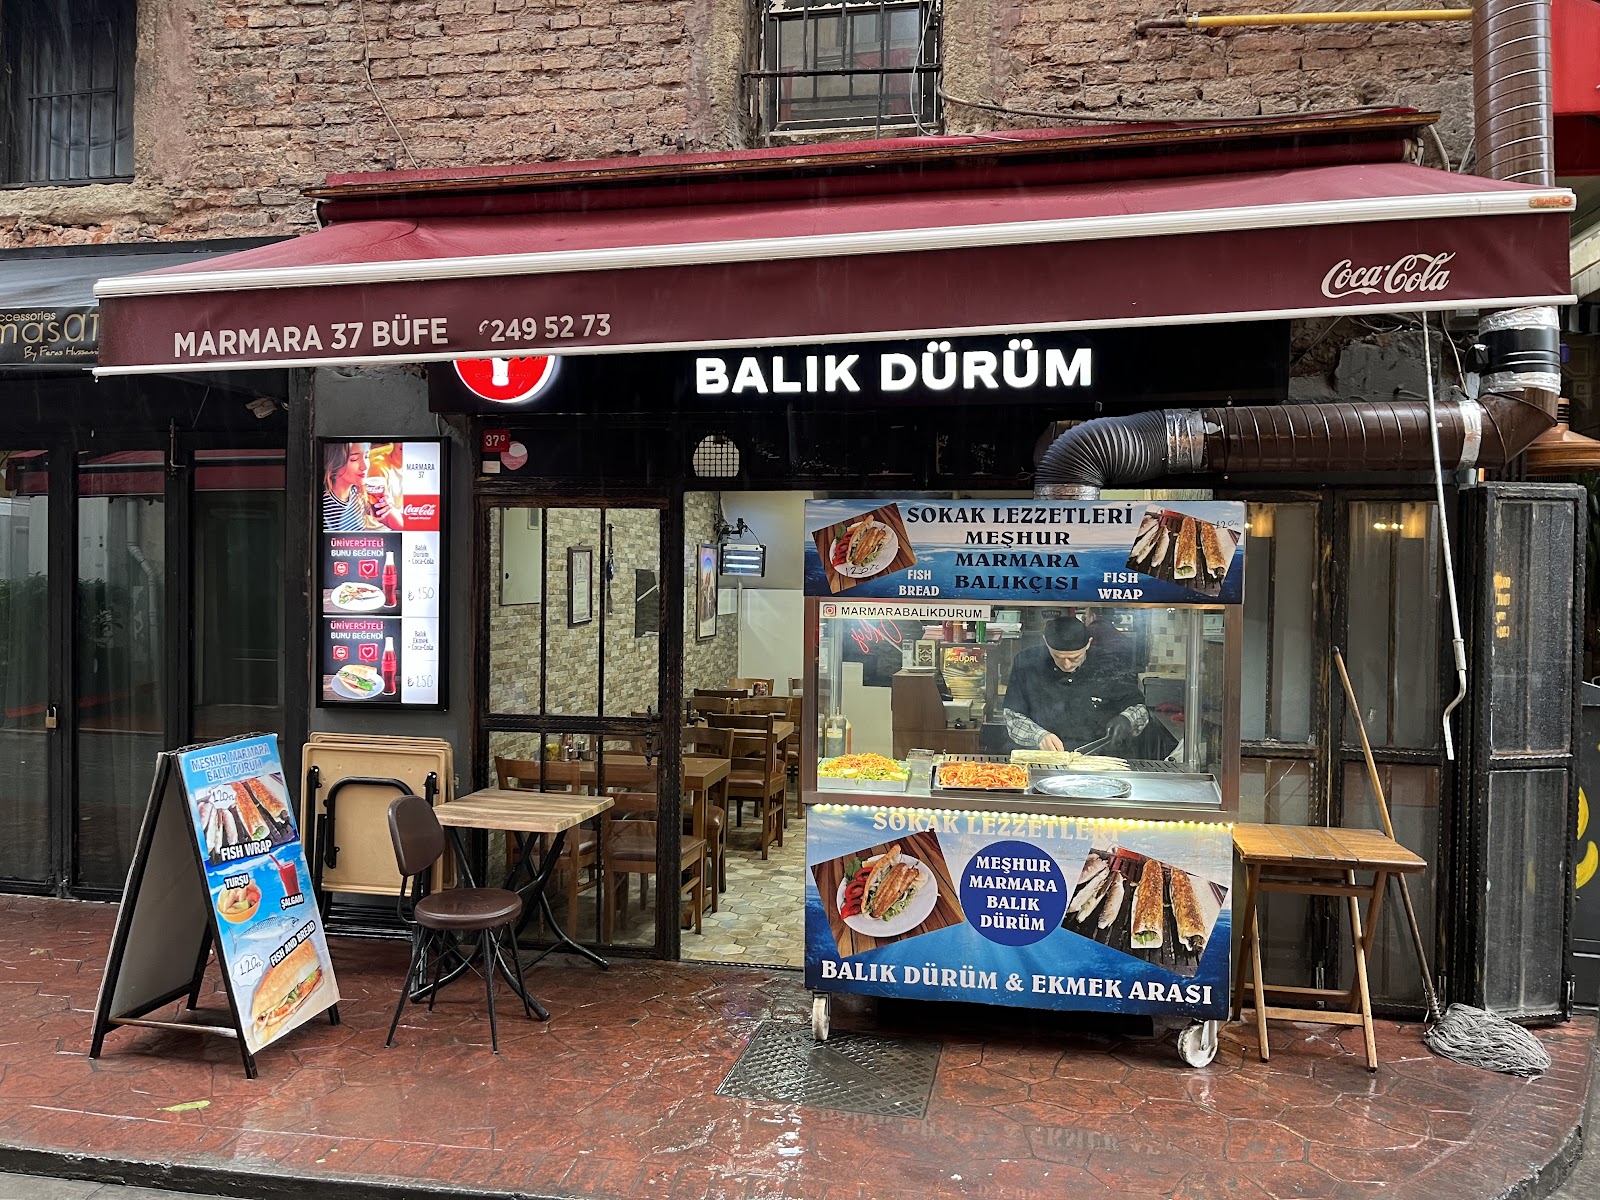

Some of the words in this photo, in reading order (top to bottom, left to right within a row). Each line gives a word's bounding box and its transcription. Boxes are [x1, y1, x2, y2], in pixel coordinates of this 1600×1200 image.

[174, 325, 323, 357] MARMARA
[331, 322, 363, 349] 37
[372, 314, 448, 347] BÜFE
[490, 317, 537, 342] 249
[544, 315, 575, 339] 52
[581, 313, 611, 337] 73
[24, 345, 37, 361] By
[696, 353, 861, 395] BALIK
[879, 338, 1093, 392] DÜRÜM
[406, 463, 435, 471] MARMARA
[907, 507, 986, 524] SOKAK
[993, 503, 1133, 524] LEZZETLERİ
[965, 530, 1071, 549] MEŞHUR
[331, 549, 351, 557] BUNU
[353, 547, 384, 557] BEĞENDİ
[955, 553, 1080, 568] MARMARA
[907, 569, 932, 581] FISH
[1103, 572, 1139, 584] FISH
[898, 585, 940, 597] BREAD
[955, 575, 1079, 594] BALIKÇISI
[1098, 588, 1143, 600] WRAP
[331, 632, 350, 640] BUNU
[352, 631, 384, 640] BEĞENDİ
[229, 745, 270, 761] MARMARA
[206, 768, 232, 782] BALIK
[873, 811, 960, 834] SOKAK
[220, 844, 244, 861] FISH
[244, 839, 272, 856] WRAP
[975, 855, 1051, 874] MEŞHUR
[224, 874, 249, 889] TURŞU
[968, 875, 1058, 893] MARMARA
[986, 895, 1040, 911] BALIK
[980, 912, 1045, 932] DÜRÜM
[270, 944, 286, 966] FISH
[283, 937, 299, 954] AND
[295, 921, 316, 945] BREAD
[821, 960, 897, 983] BALIK
[903, 962, 998, 990] DÜRÜM
[1005, 972, 1025, 992] &
[1031, 974, 1123, 999] EKMEK
[1128, 981, 1212, 1005] ARASI
